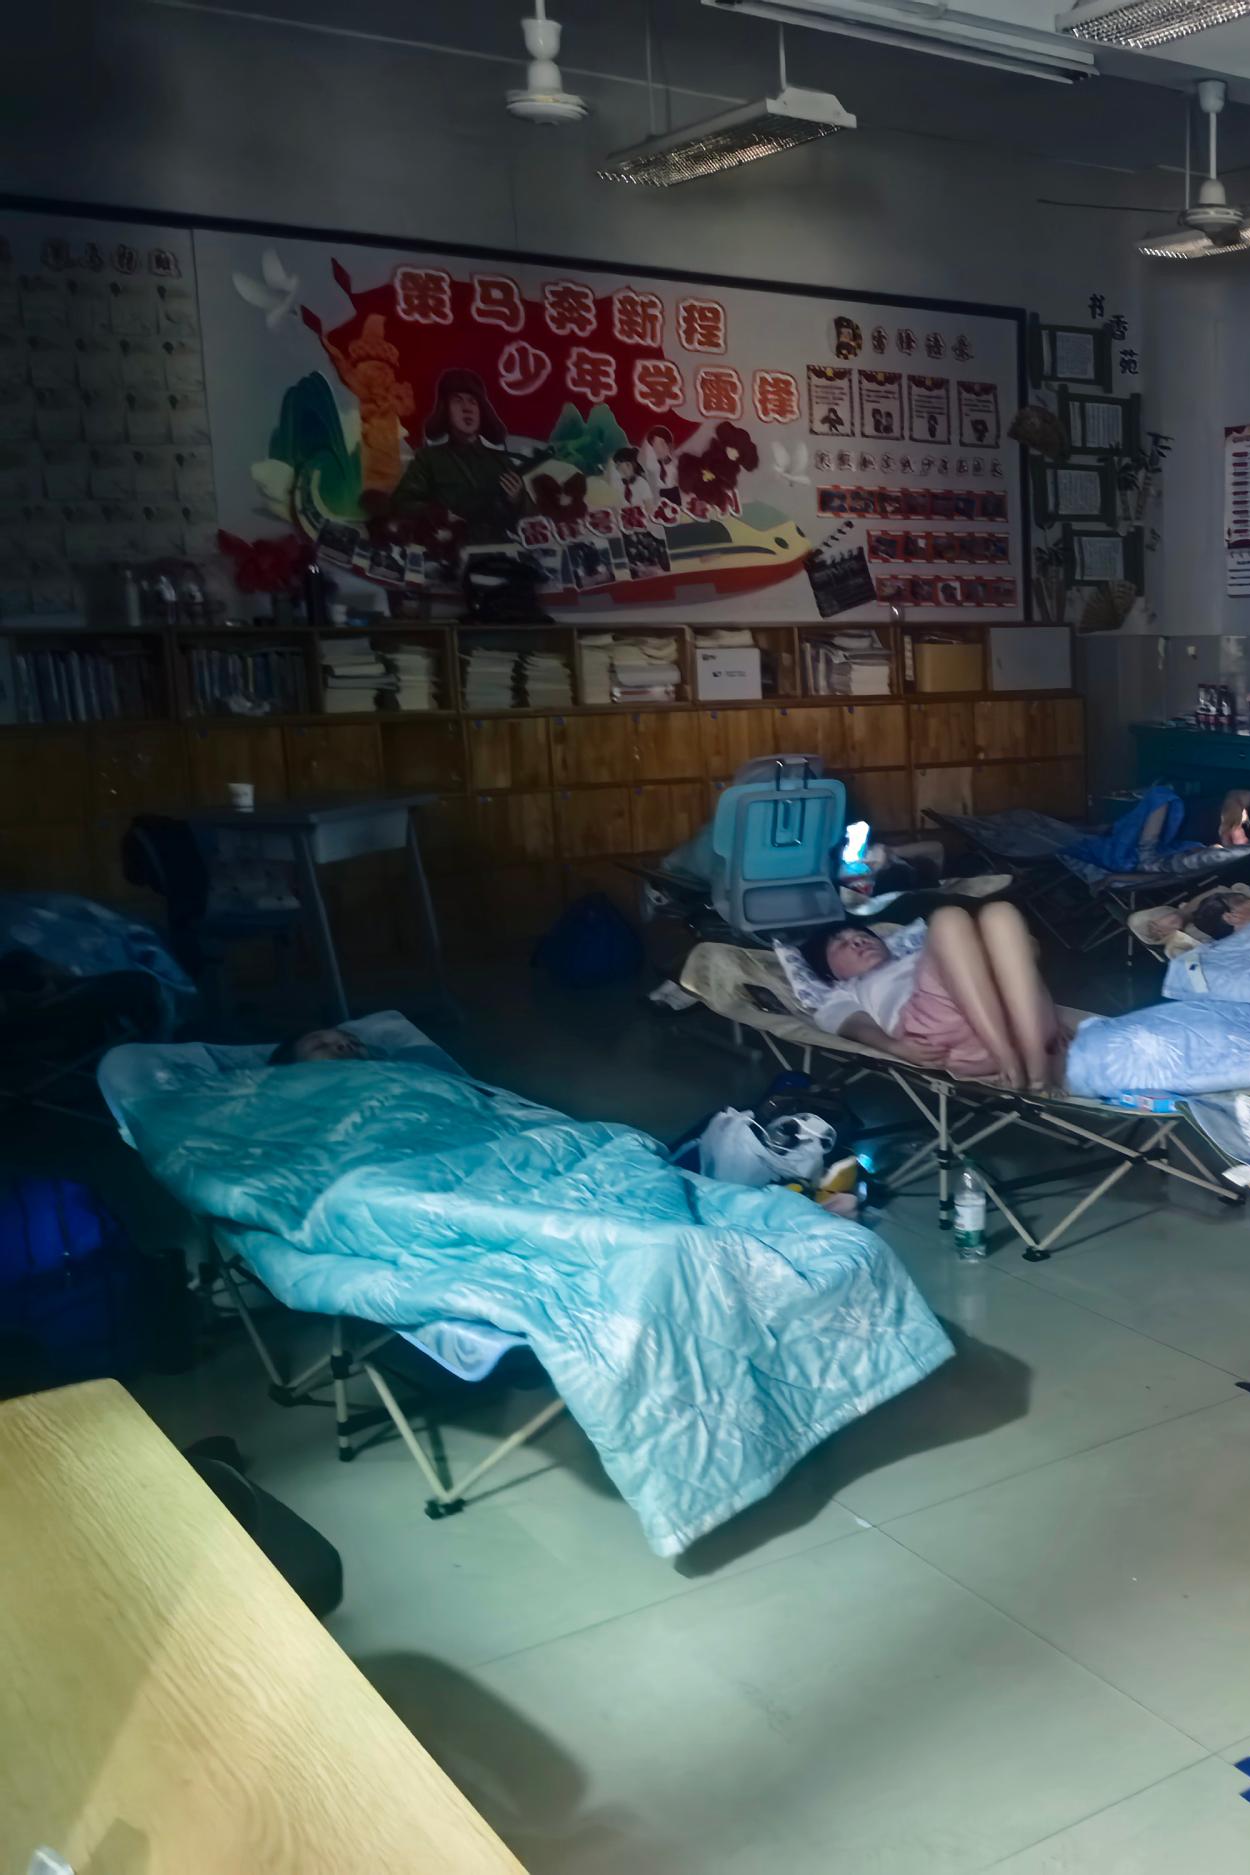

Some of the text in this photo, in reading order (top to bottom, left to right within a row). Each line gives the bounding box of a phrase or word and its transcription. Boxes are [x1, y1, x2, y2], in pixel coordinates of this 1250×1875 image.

[395, 268, 727, 352] 策马奔新程
[500, 340, 799, 424] 少年学雷锋
